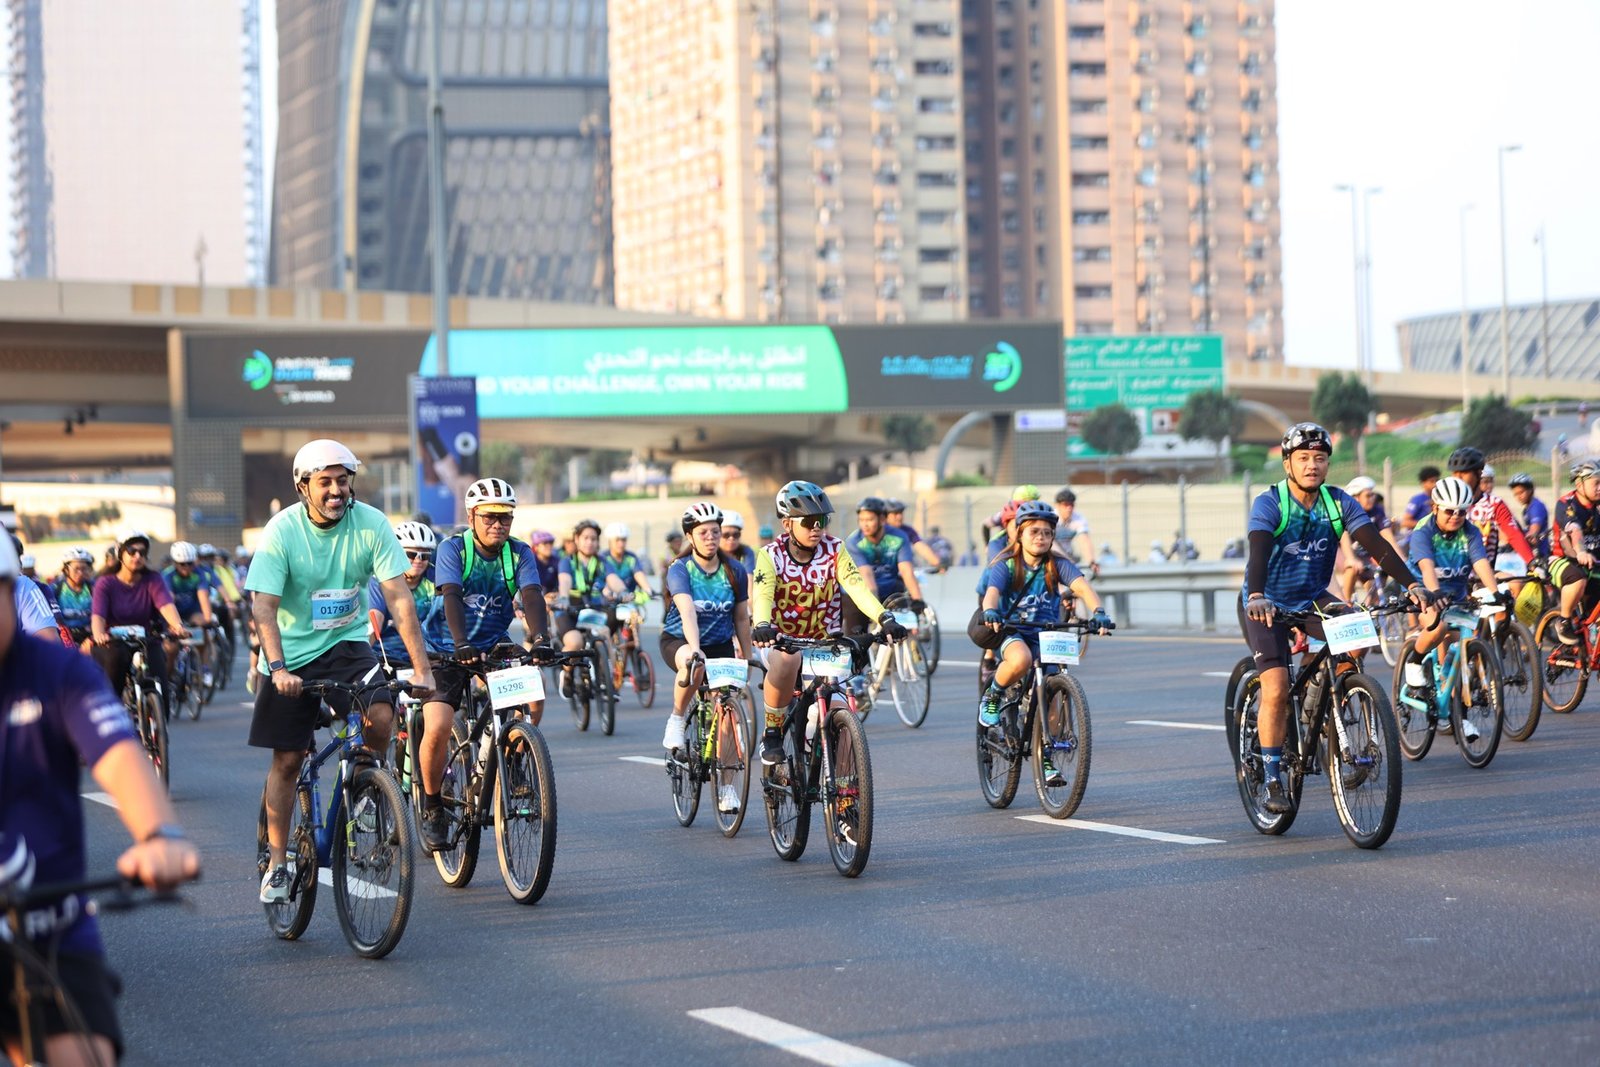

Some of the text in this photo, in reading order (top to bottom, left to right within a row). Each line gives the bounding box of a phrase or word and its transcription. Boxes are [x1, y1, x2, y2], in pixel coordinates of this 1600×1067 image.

[501, 375, 548, 394] YOUR
[714, 373, 762, 391] YOUR
[320, 604, 350, 615] 01793
[703, 600, 732, 612] CMC
[1334, 627, 1360, 641] 15291
[1046, 644, 1067, 652] 20709
[810, 653, 836, 663] 15320
[497, 681, 525, 694] 15298
